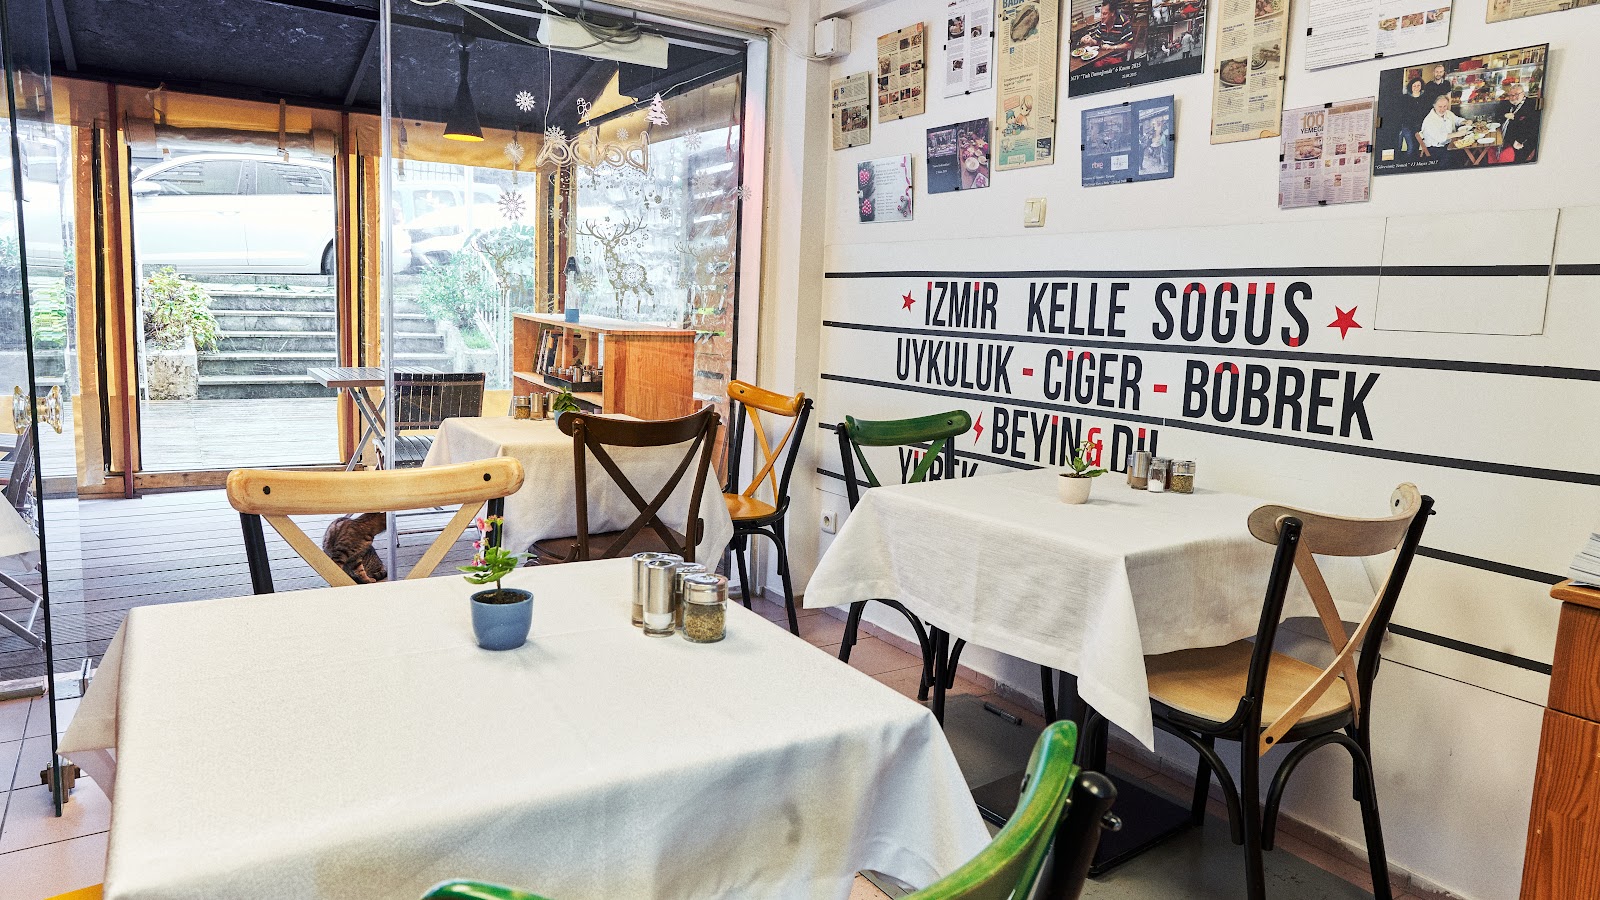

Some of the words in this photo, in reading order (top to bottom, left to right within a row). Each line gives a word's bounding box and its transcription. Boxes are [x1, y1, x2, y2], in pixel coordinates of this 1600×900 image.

[1300, 113, 1325, 129] 100
[1027, 282, 1130, 337] KELLE
[896, 337, 1015, 394] UYKULUK
